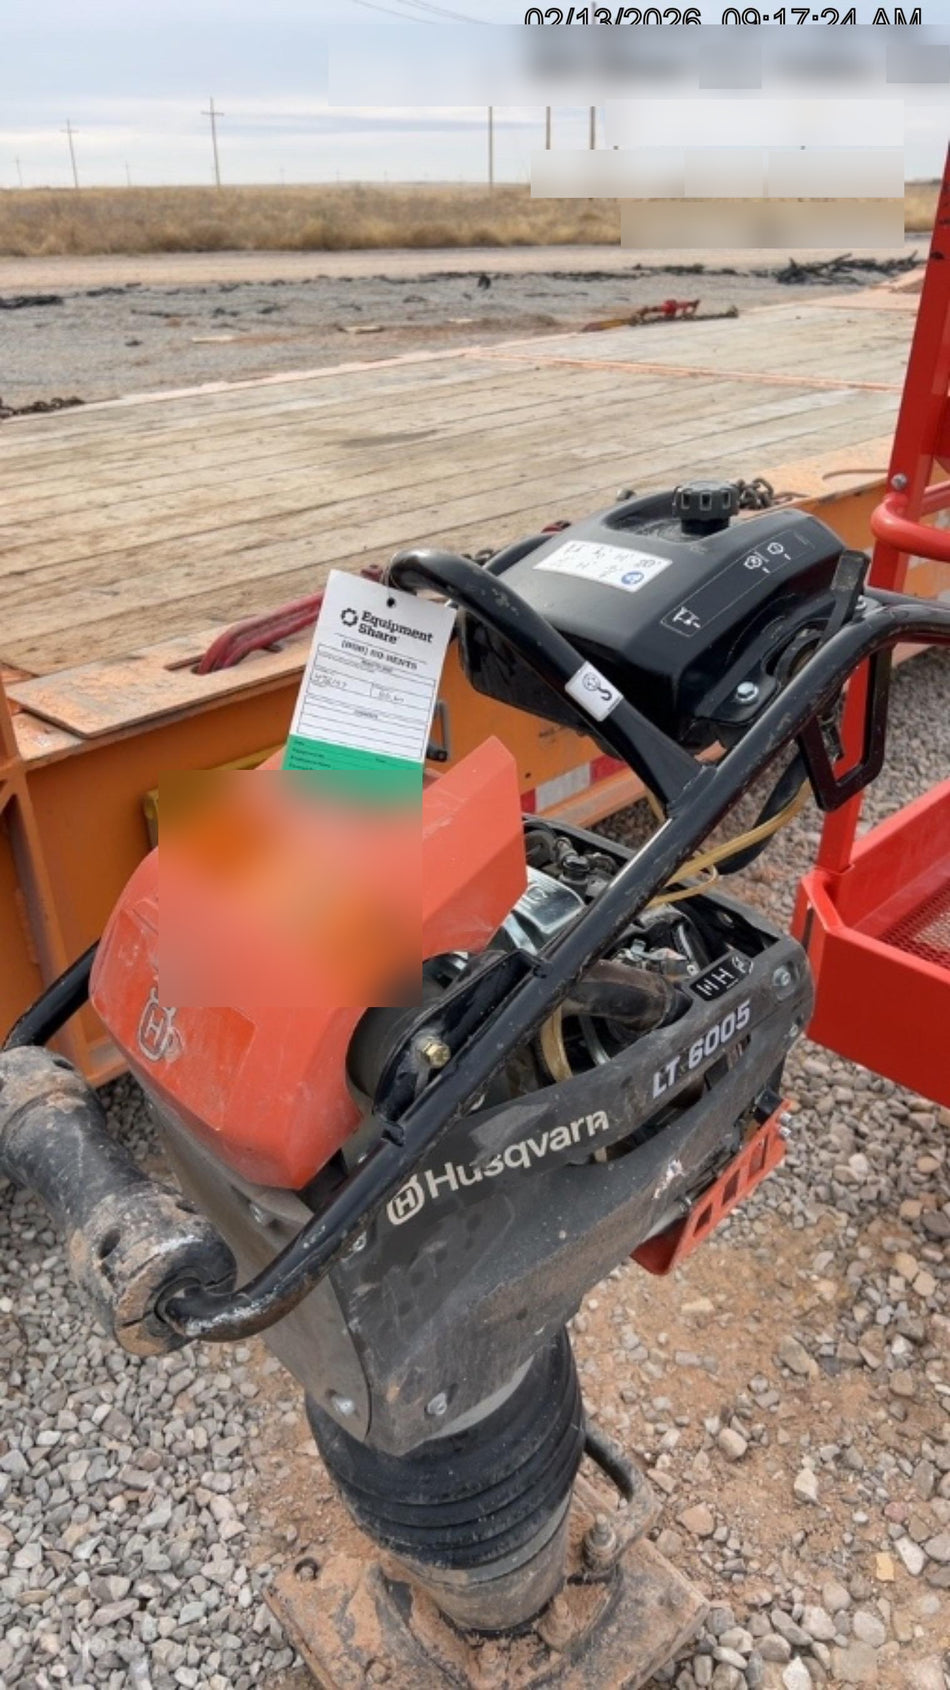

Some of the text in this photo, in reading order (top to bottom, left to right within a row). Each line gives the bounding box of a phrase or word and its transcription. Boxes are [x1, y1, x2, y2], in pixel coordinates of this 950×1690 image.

[358, 623, 398, 645] Share
[361, 610, 434, 643] Equipment
[652, 1000, 751, 1099] LT 6005
